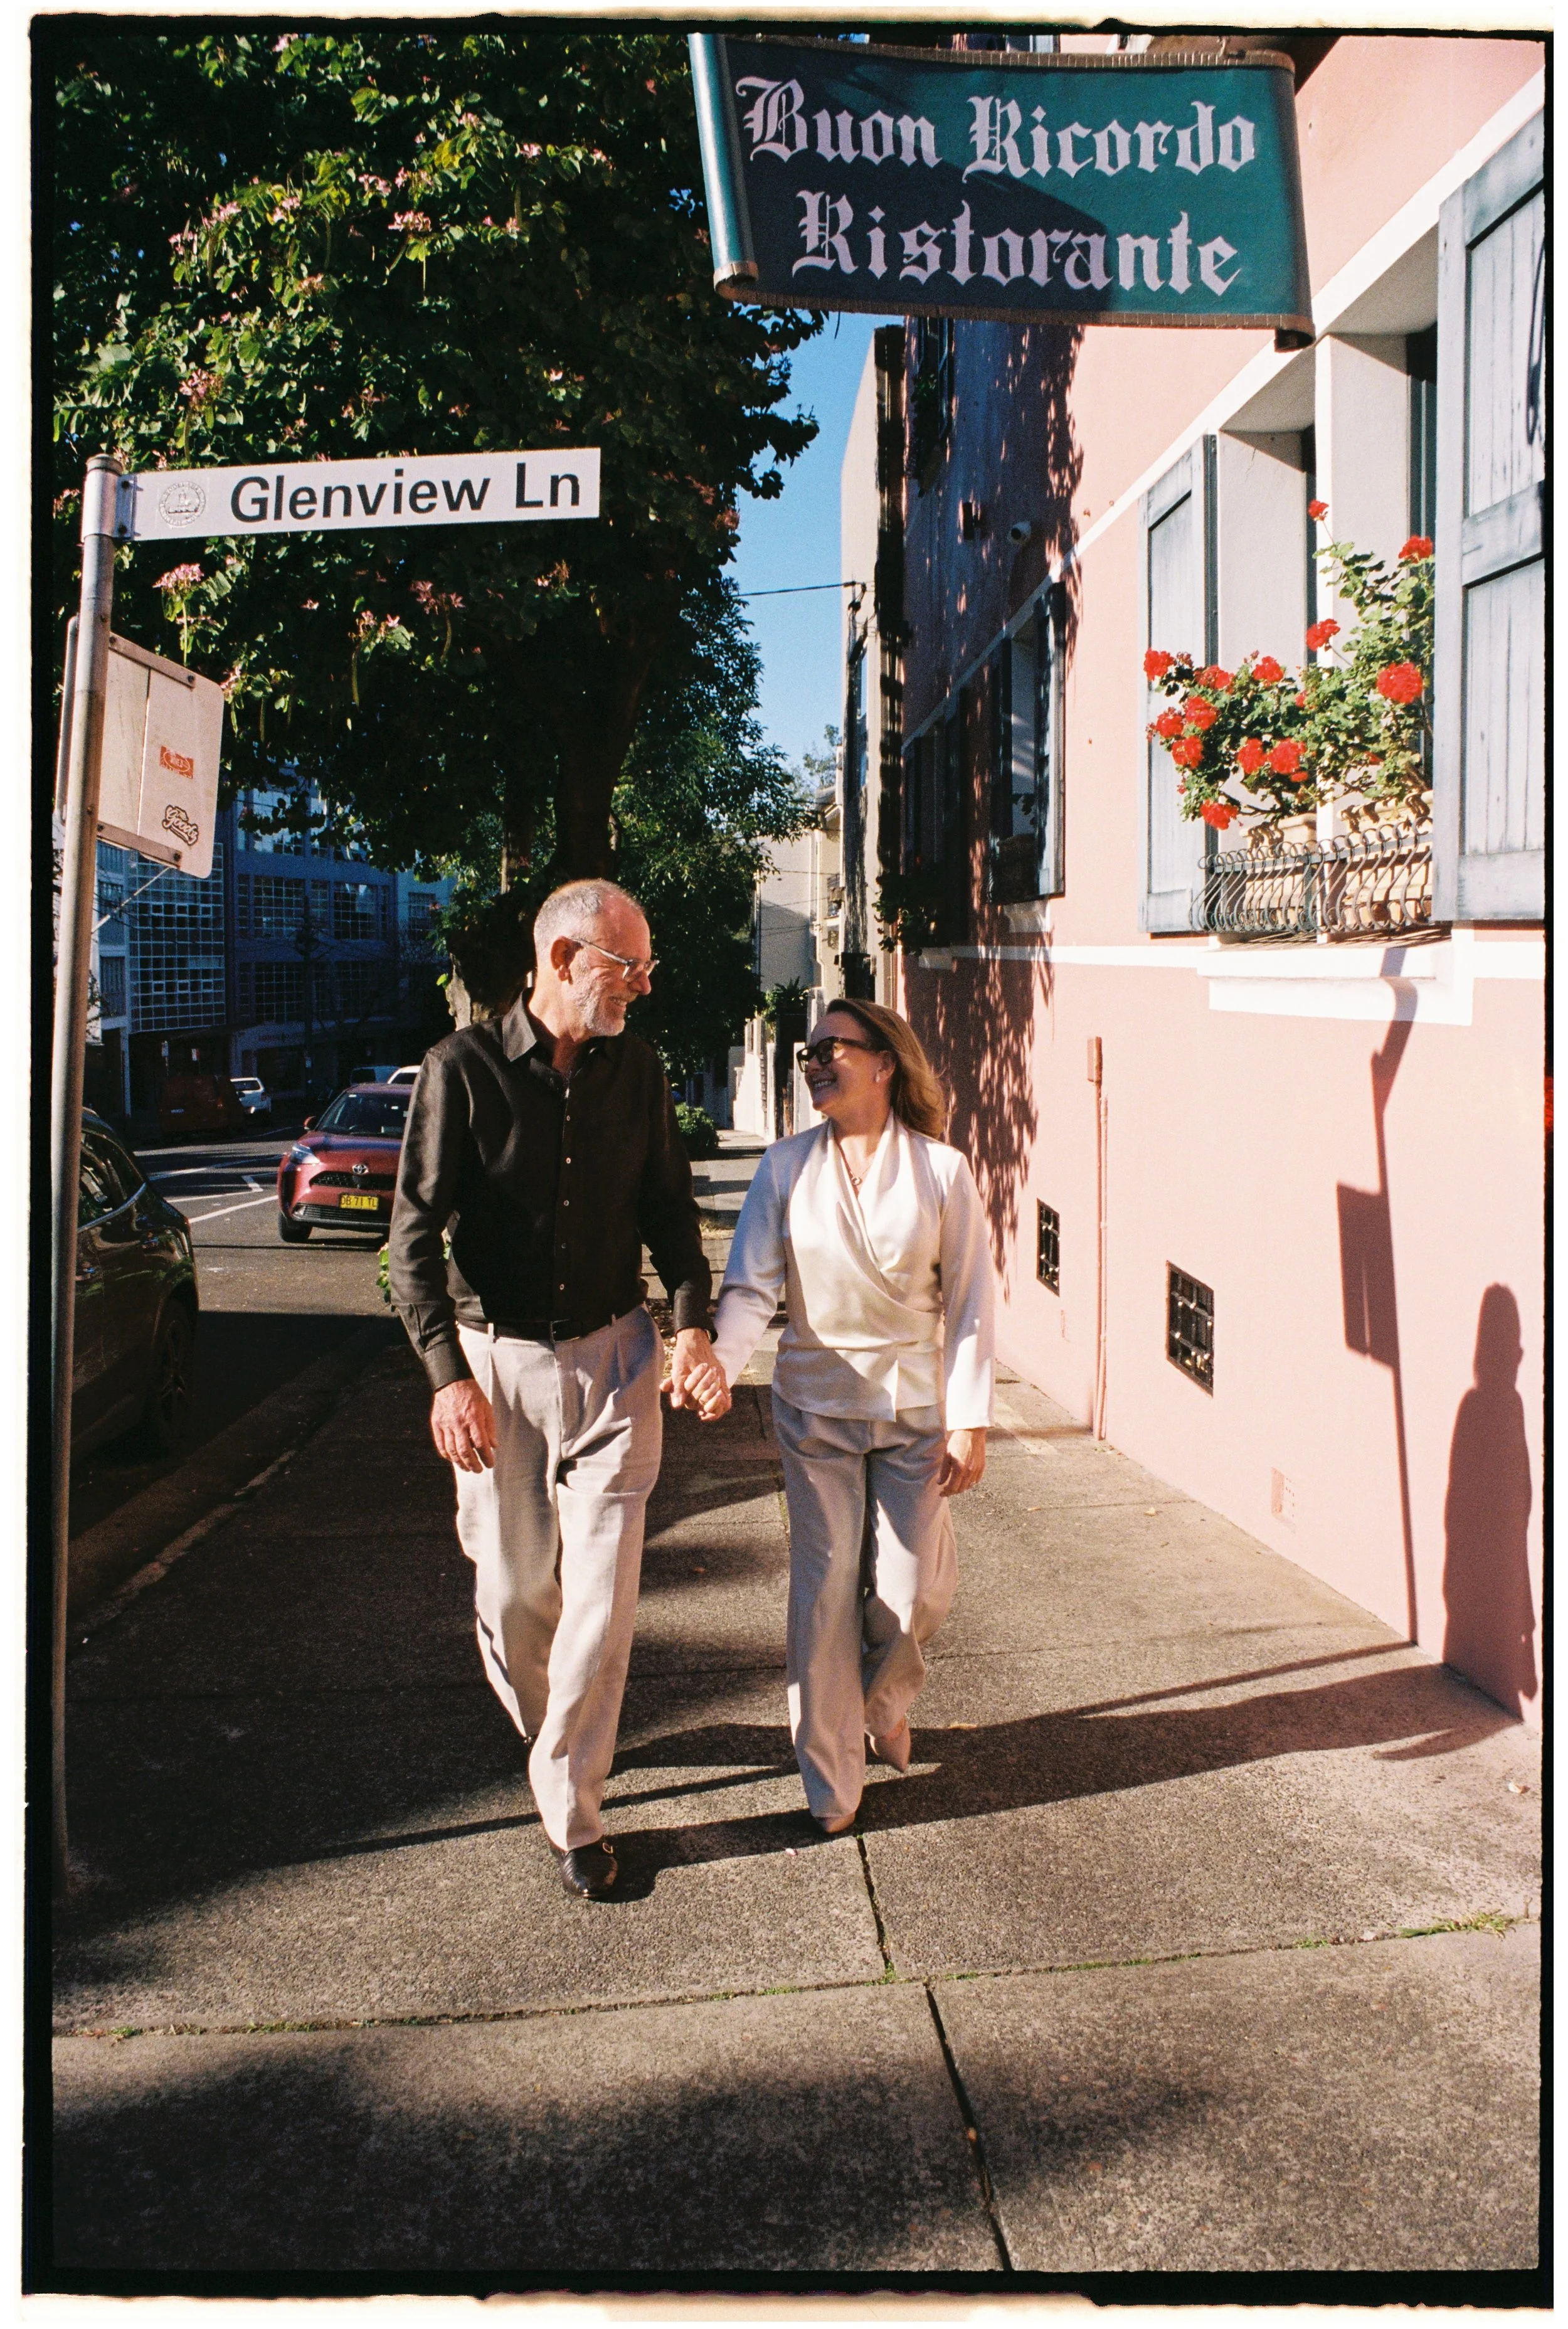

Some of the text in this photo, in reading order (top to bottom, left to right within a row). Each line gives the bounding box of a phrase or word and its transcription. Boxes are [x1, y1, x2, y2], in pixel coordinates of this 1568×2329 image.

[736, 77, 1255, 183] Buon Ricordo
[792, 190, 1241, 297] Ristorante
[231, 469, 491, 523] Glenview
[516, 462, 580, 509] Ln
